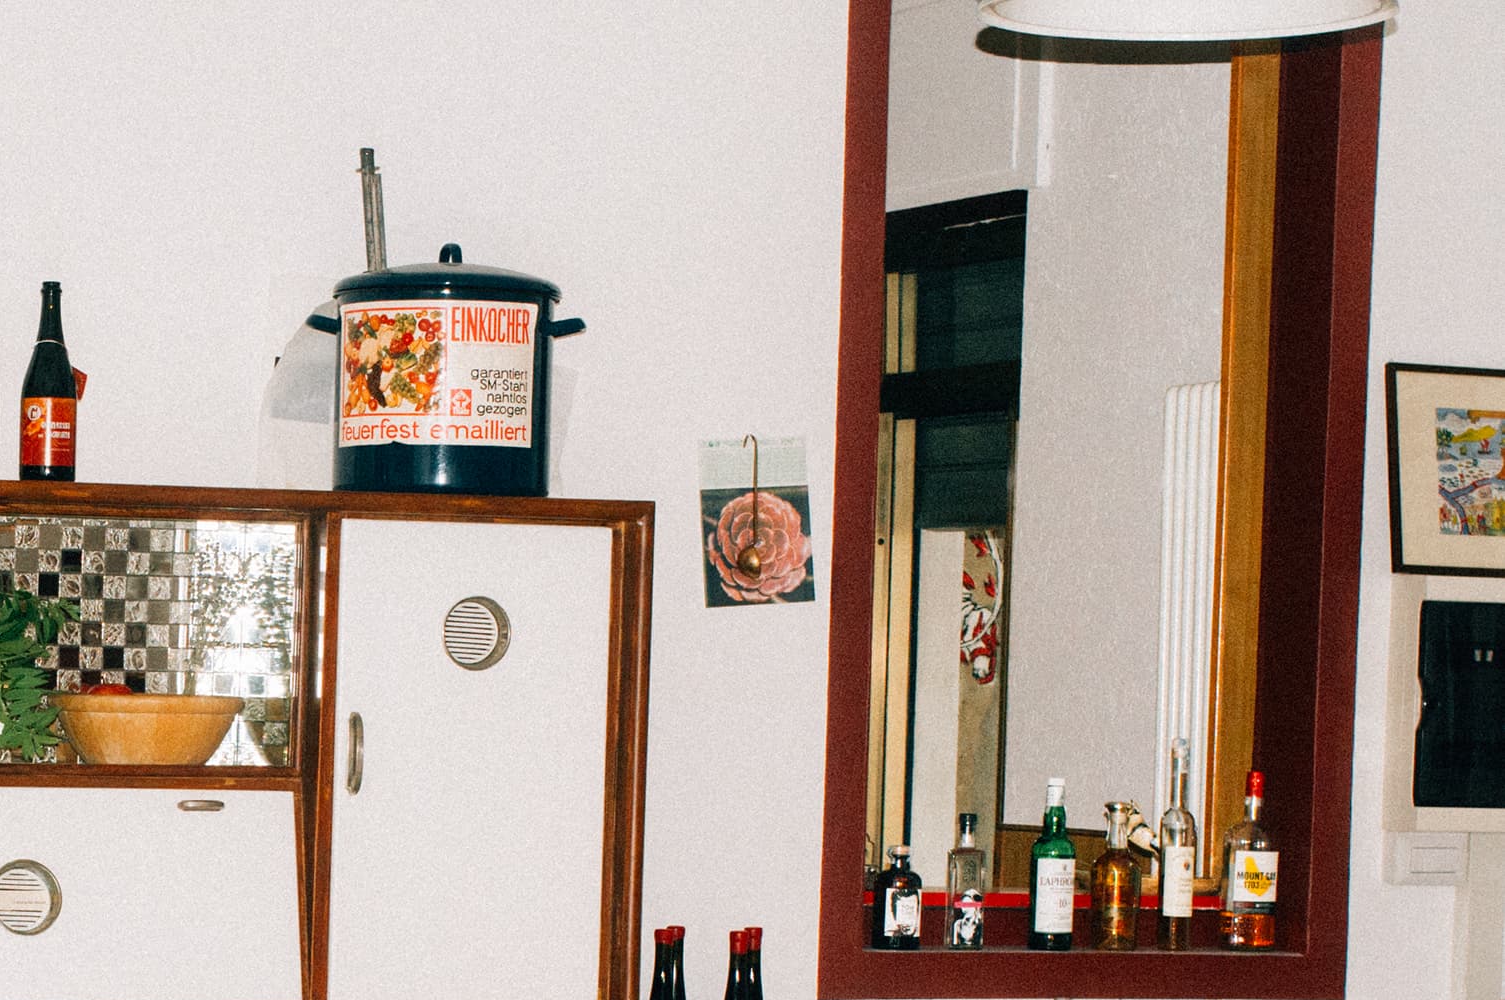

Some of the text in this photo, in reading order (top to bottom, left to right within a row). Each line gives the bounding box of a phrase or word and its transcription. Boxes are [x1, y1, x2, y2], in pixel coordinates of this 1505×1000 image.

[450, 306, 531, 345] EINKOCHER
[470, 368, 528, 380] garantiert
[479, 379, 528, 392] SM-Stahl
[486, 392, 527, 405] nahtlos
[476, 405, 527, 418] gezogen
[342, 418, 528, 442] feuerfest emailliert
[1237, 871, 1264, 881] MOUNT
